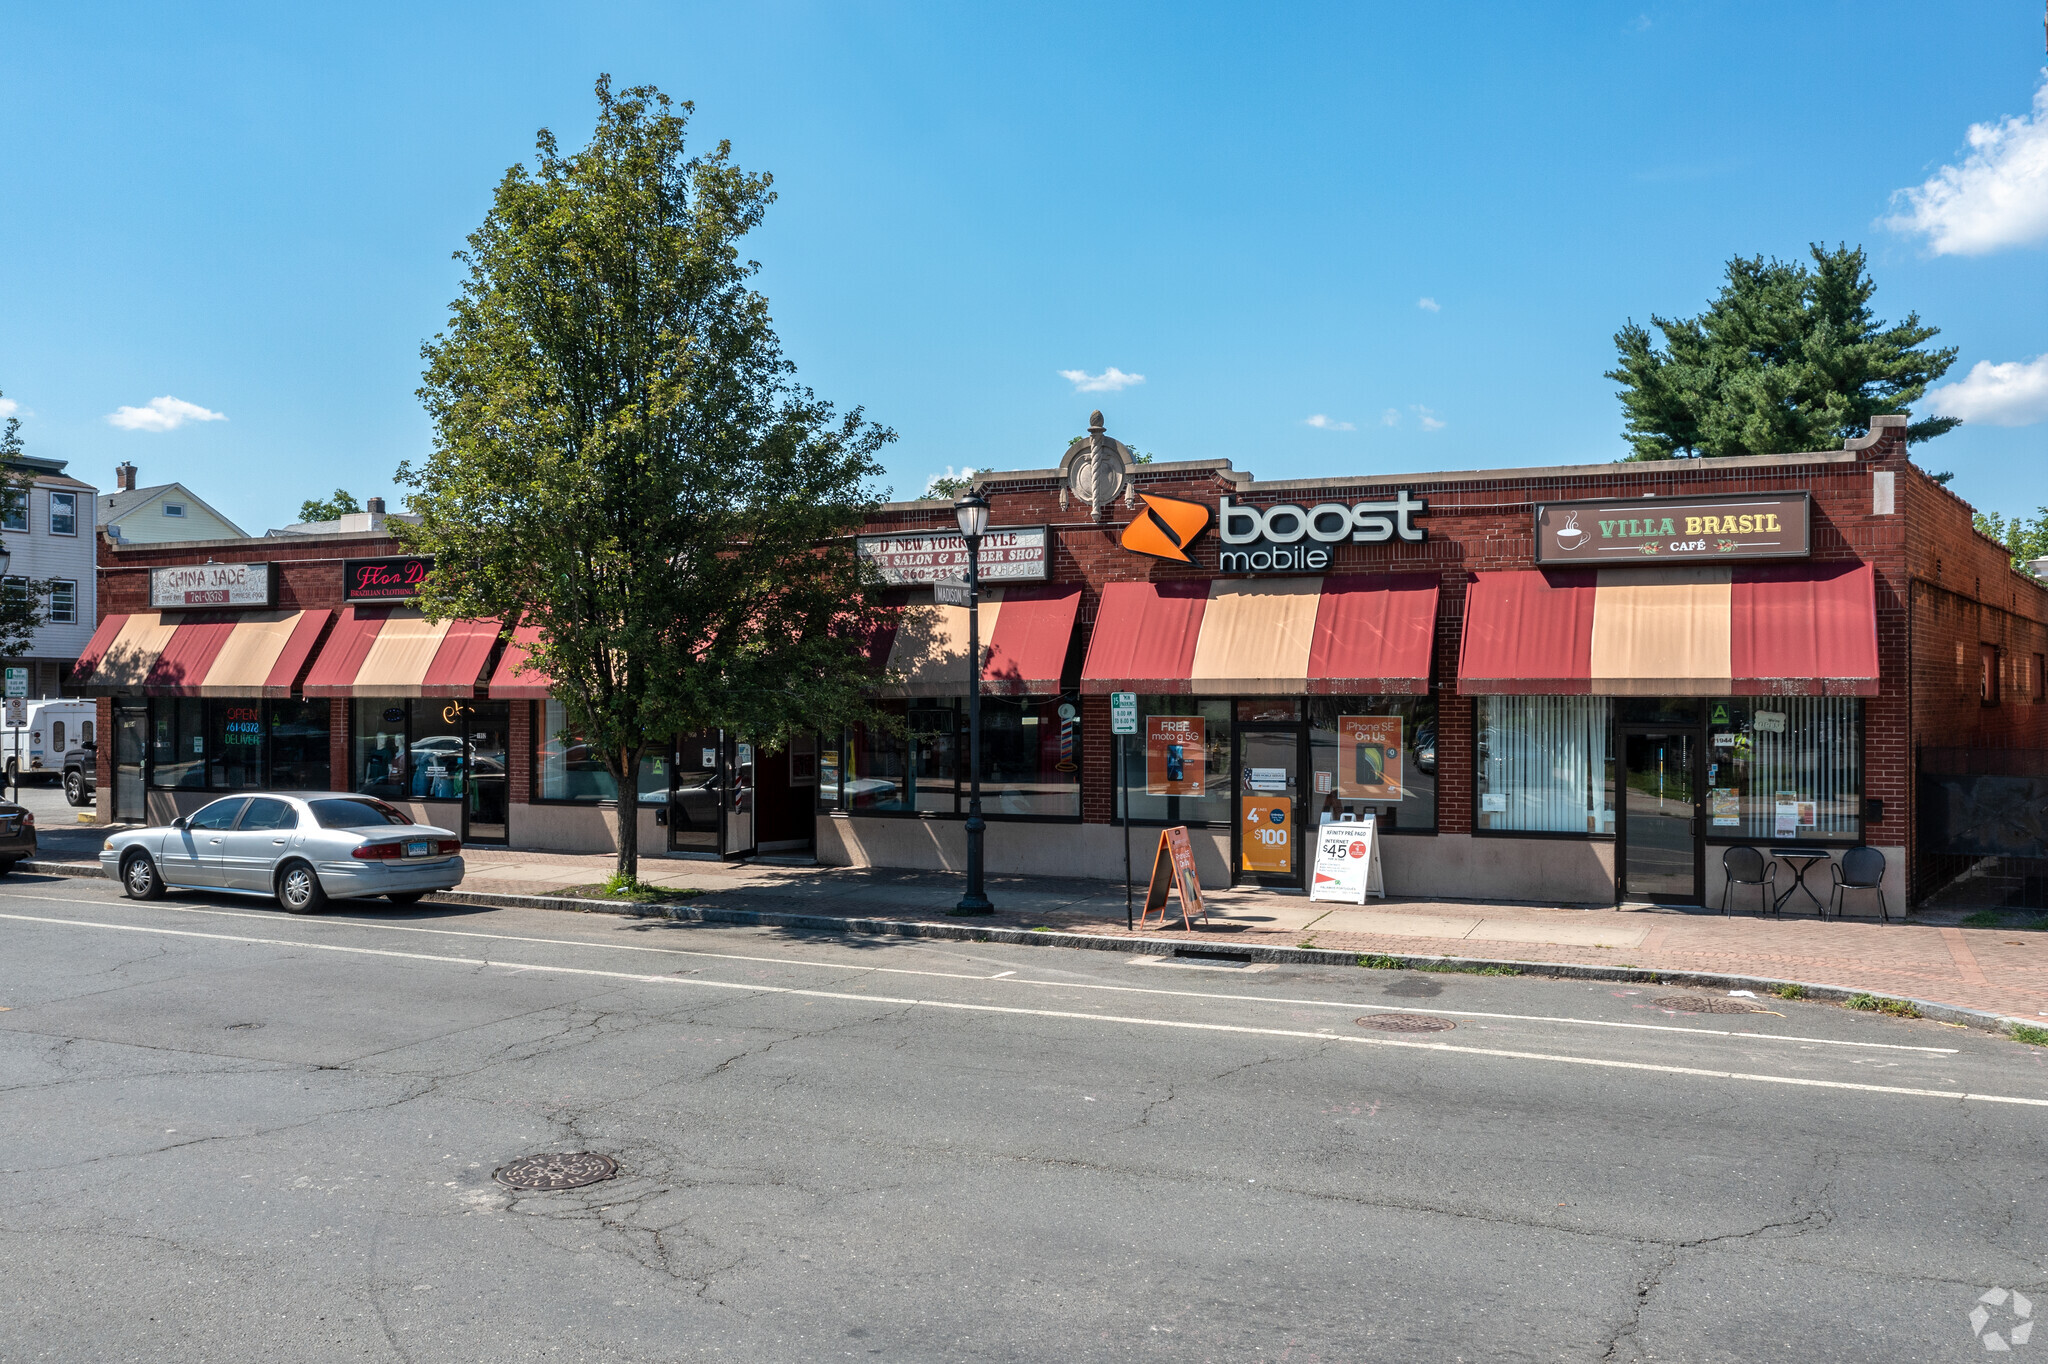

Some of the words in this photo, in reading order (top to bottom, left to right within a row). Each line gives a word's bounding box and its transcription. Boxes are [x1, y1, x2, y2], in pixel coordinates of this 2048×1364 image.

[1219, 490, 1423, 545] boost
[1598, 517, 1676, 538] VILLA
[1684, 513, 1782, 536] BRASIL
[895, 537, 924, 552] NEW
[929, 535, 967, 550] YORK
[981, 533, 1017, 548] TYLE
[1669, 538, 1707, 552] CAFÉ
[893, 552, 934, 566] SALON
[938, 553, 950, 564] &
[953, 550, 1004, 563] BABER
[1008, 548, 1042, 560] SHOP
[1219, 545, 1328, 571] mobile
[168, 570, 206, 588] CHINA
[210, 568, 246, 586] JADE
[356, 564, 402, 590] Flor
[190, 591, 224, 603] 761-0378
[350, 588, 381, 597] BRAZILIAN
[381, 587, 413, 596] CLOTHING
[936, 587, 962, 603] MADISON
[1113, 696, 1119, 706] 15
[226, 707, 258, 721] OPEN
[1713, 704, 1727, 718] A
[1160, 720, 1190, 732] FREE
[1346, 721, 1380, 731] iPhone
[1381, 721, 1395, 732] SE
[224, 733, 260, 746] DELIVER
[1152, 732, 1176, 740] moto
[1176, 733, 1184, 743] g
[1185, 731, 1200, 741] 5G
[1354, 731, 1370, 741] On
[1372, 731, 1386, 741] Us
[654, 759, 662, 769] A
[1246, 807, 1260, 823] 4
[1253, 828, 1288, 846] $100
[1322, 844, 1347, 859] $45
